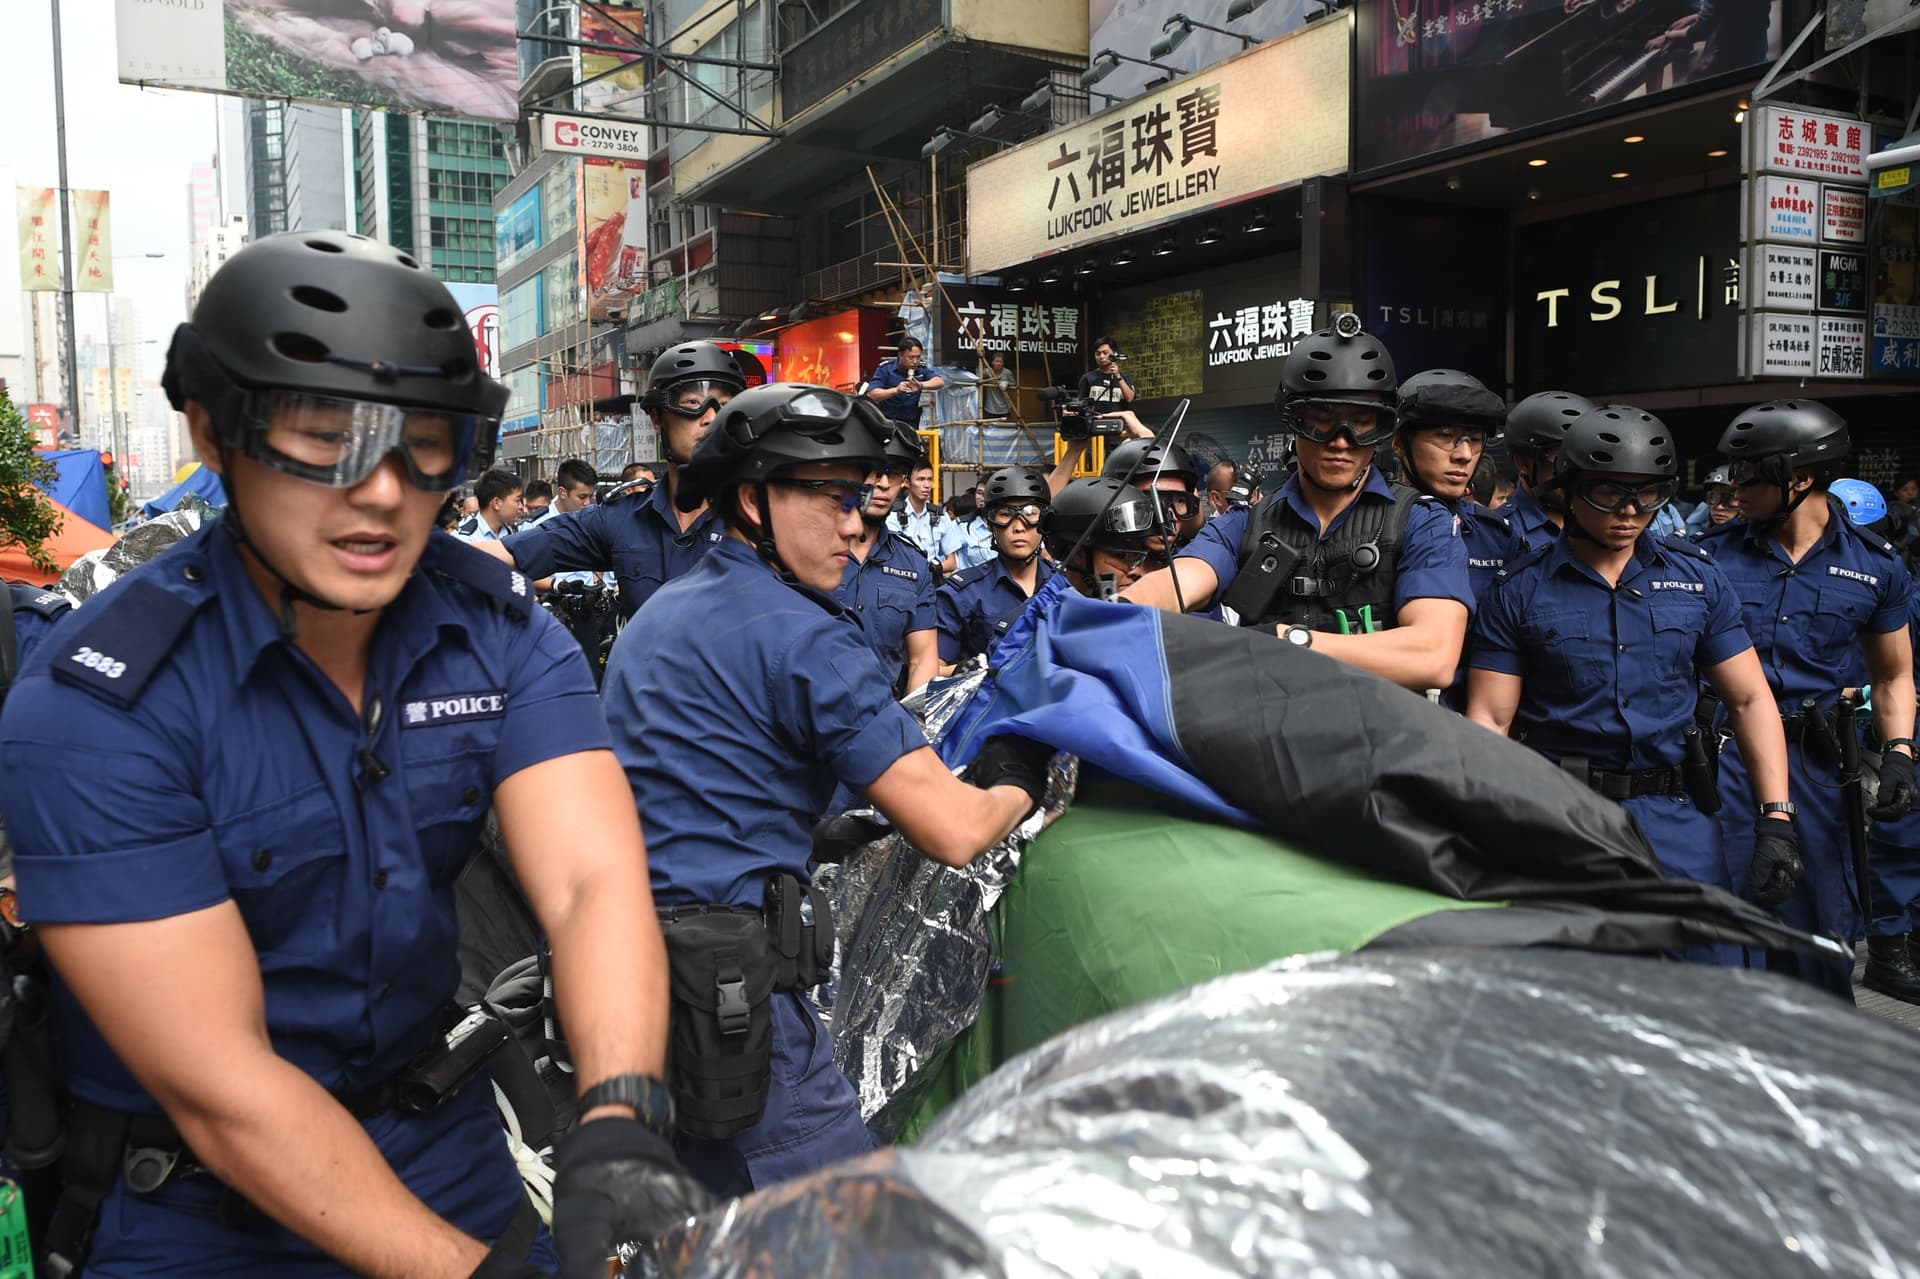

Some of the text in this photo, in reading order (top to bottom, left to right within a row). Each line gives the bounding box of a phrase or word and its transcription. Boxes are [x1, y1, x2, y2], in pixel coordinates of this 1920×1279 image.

[580, 125, 638, 142] CONVEY
[1778, 116, 1862, 151] 志城賓館
[592, 140, 639, 152] 2739 3806
[1047, 83, 1221, 211] 六福珠寶
[1048, 165, 1220, 240] LUKFOOK JEWELLERY
[1830, 255, 1858, 272] MGM
[1536, 275, 1678, 328] TSL
[957, 301, 1079, 340] 六福珠寶
[1209, 297, 1315, 350] 六福珠寶
[1380, 305, 1429, 325] TSL
[958, 337, 1078, 354] LUKFOOK JEWELLERY
[1209, 341, 1301, 366] LUKFOOK JEWELL
[890, 567, 912, 577] POLICE
[1469, 558, 1496, 567] POLICE
[1839, 568, 1869, 582] POLICE
[1663, 581, 1694, 591] POLICE
[431, 695, 504, 718] POLICE
